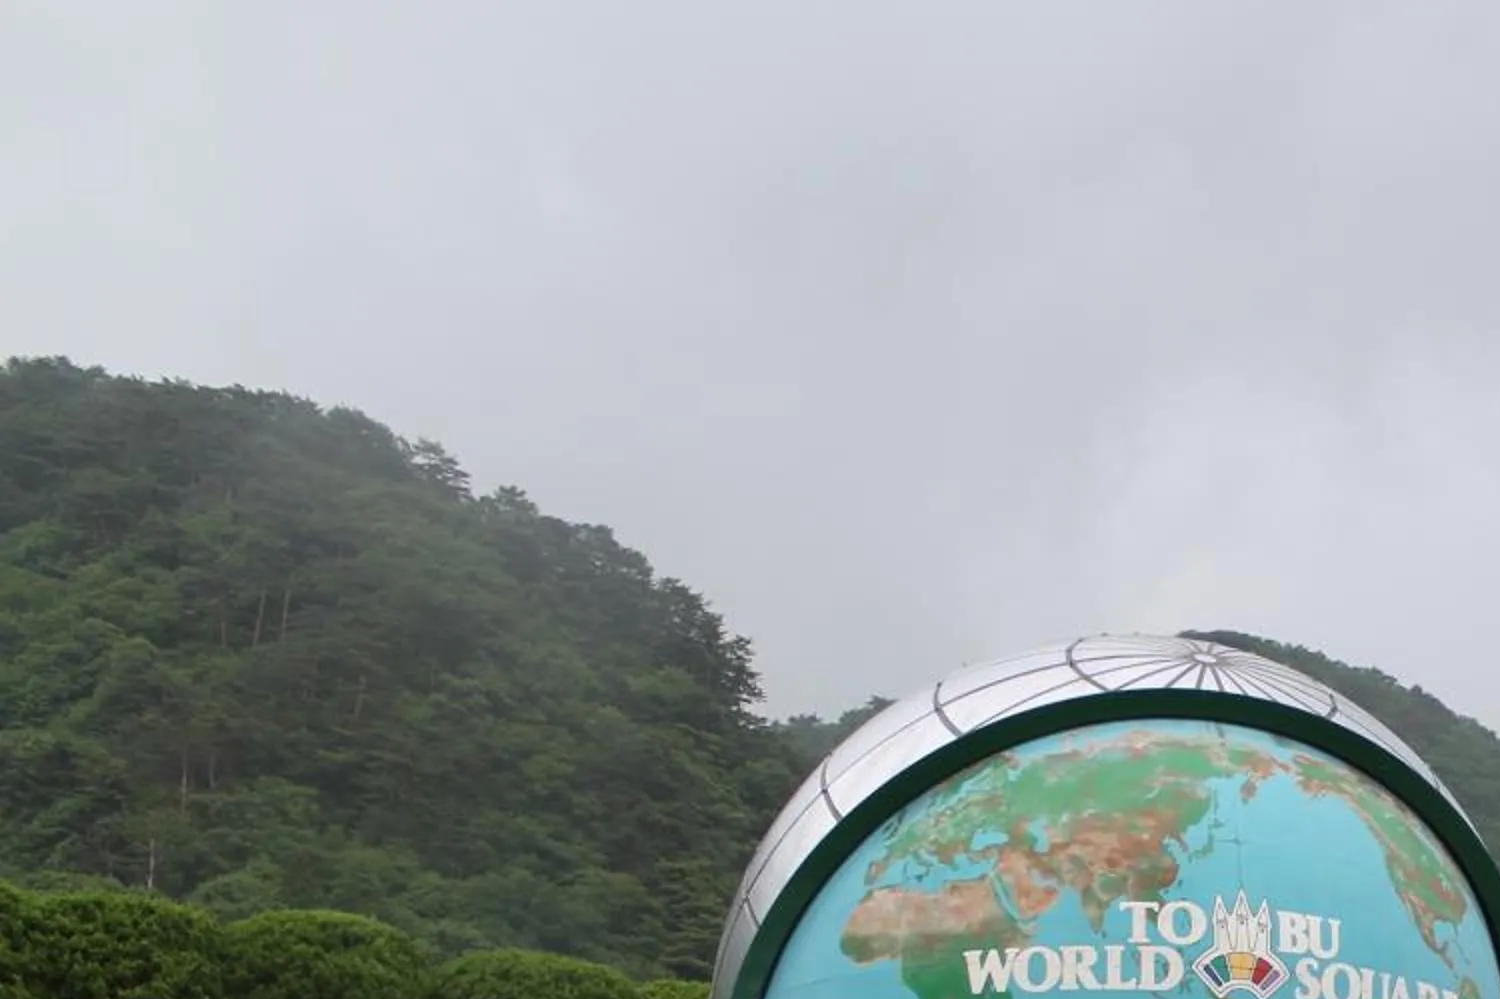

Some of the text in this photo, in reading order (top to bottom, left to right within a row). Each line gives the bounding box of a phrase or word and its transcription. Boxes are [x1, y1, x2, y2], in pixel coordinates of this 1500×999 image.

[1120, 900, 1341, 960] TO BU
[962, 945, 1185, 995] WORLD
